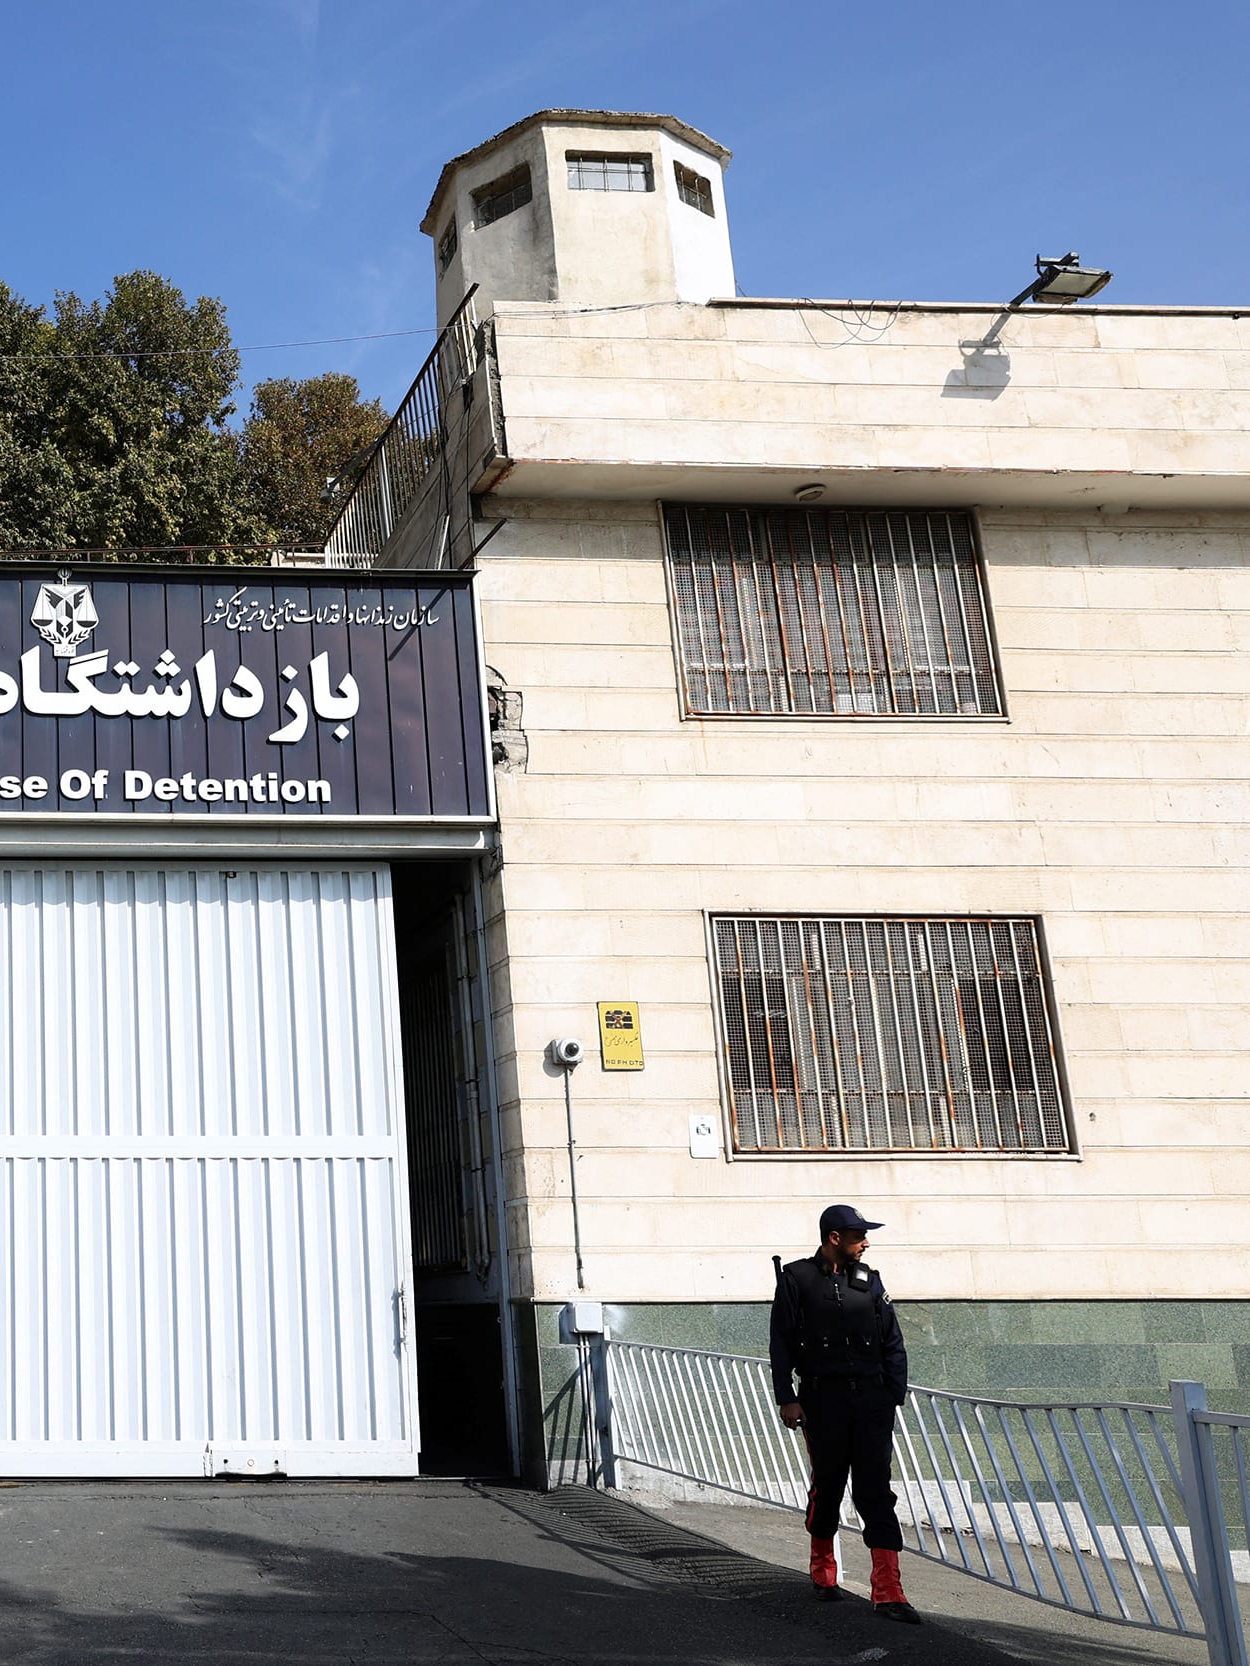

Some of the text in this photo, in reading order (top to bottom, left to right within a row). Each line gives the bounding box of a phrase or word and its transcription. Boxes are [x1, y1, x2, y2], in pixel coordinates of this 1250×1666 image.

[203, 586, 248, 624] کشور
[292, 604, 347, 624] اقدامات
[393, 604, 440, 630] سازمان
[59, 769, 109, 800] Of
[124, 770, 332, 802] Detention
